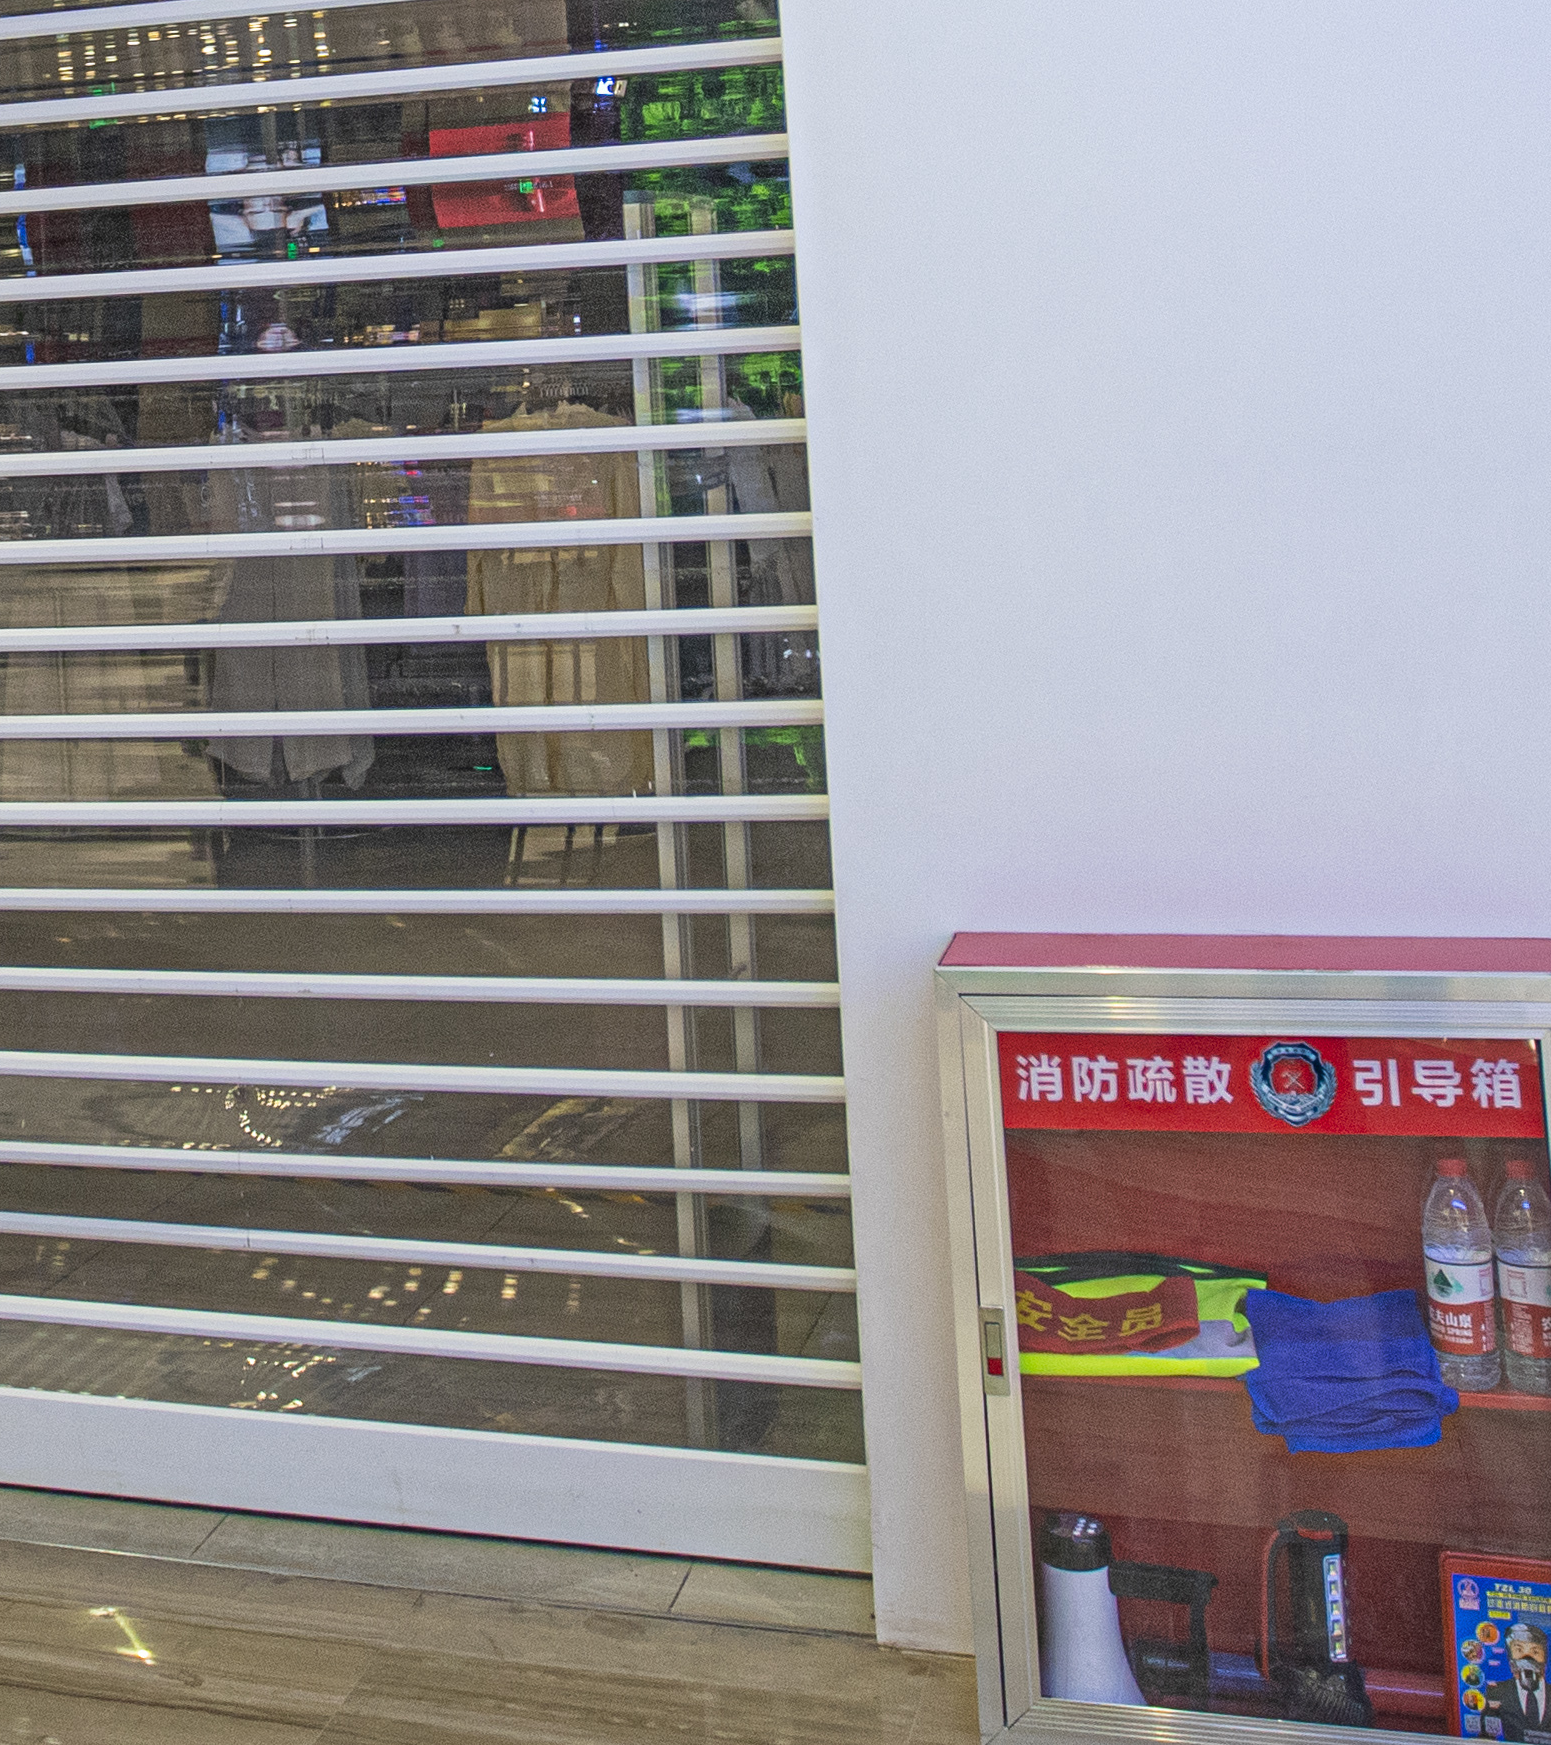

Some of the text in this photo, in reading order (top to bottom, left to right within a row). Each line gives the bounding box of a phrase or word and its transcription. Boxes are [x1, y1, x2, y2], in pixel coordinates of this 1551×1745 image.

[1016, 1054, 1524, 1110] 消防疏散 引导箱
[1016, 1290, 1163, 1342] 安全员
